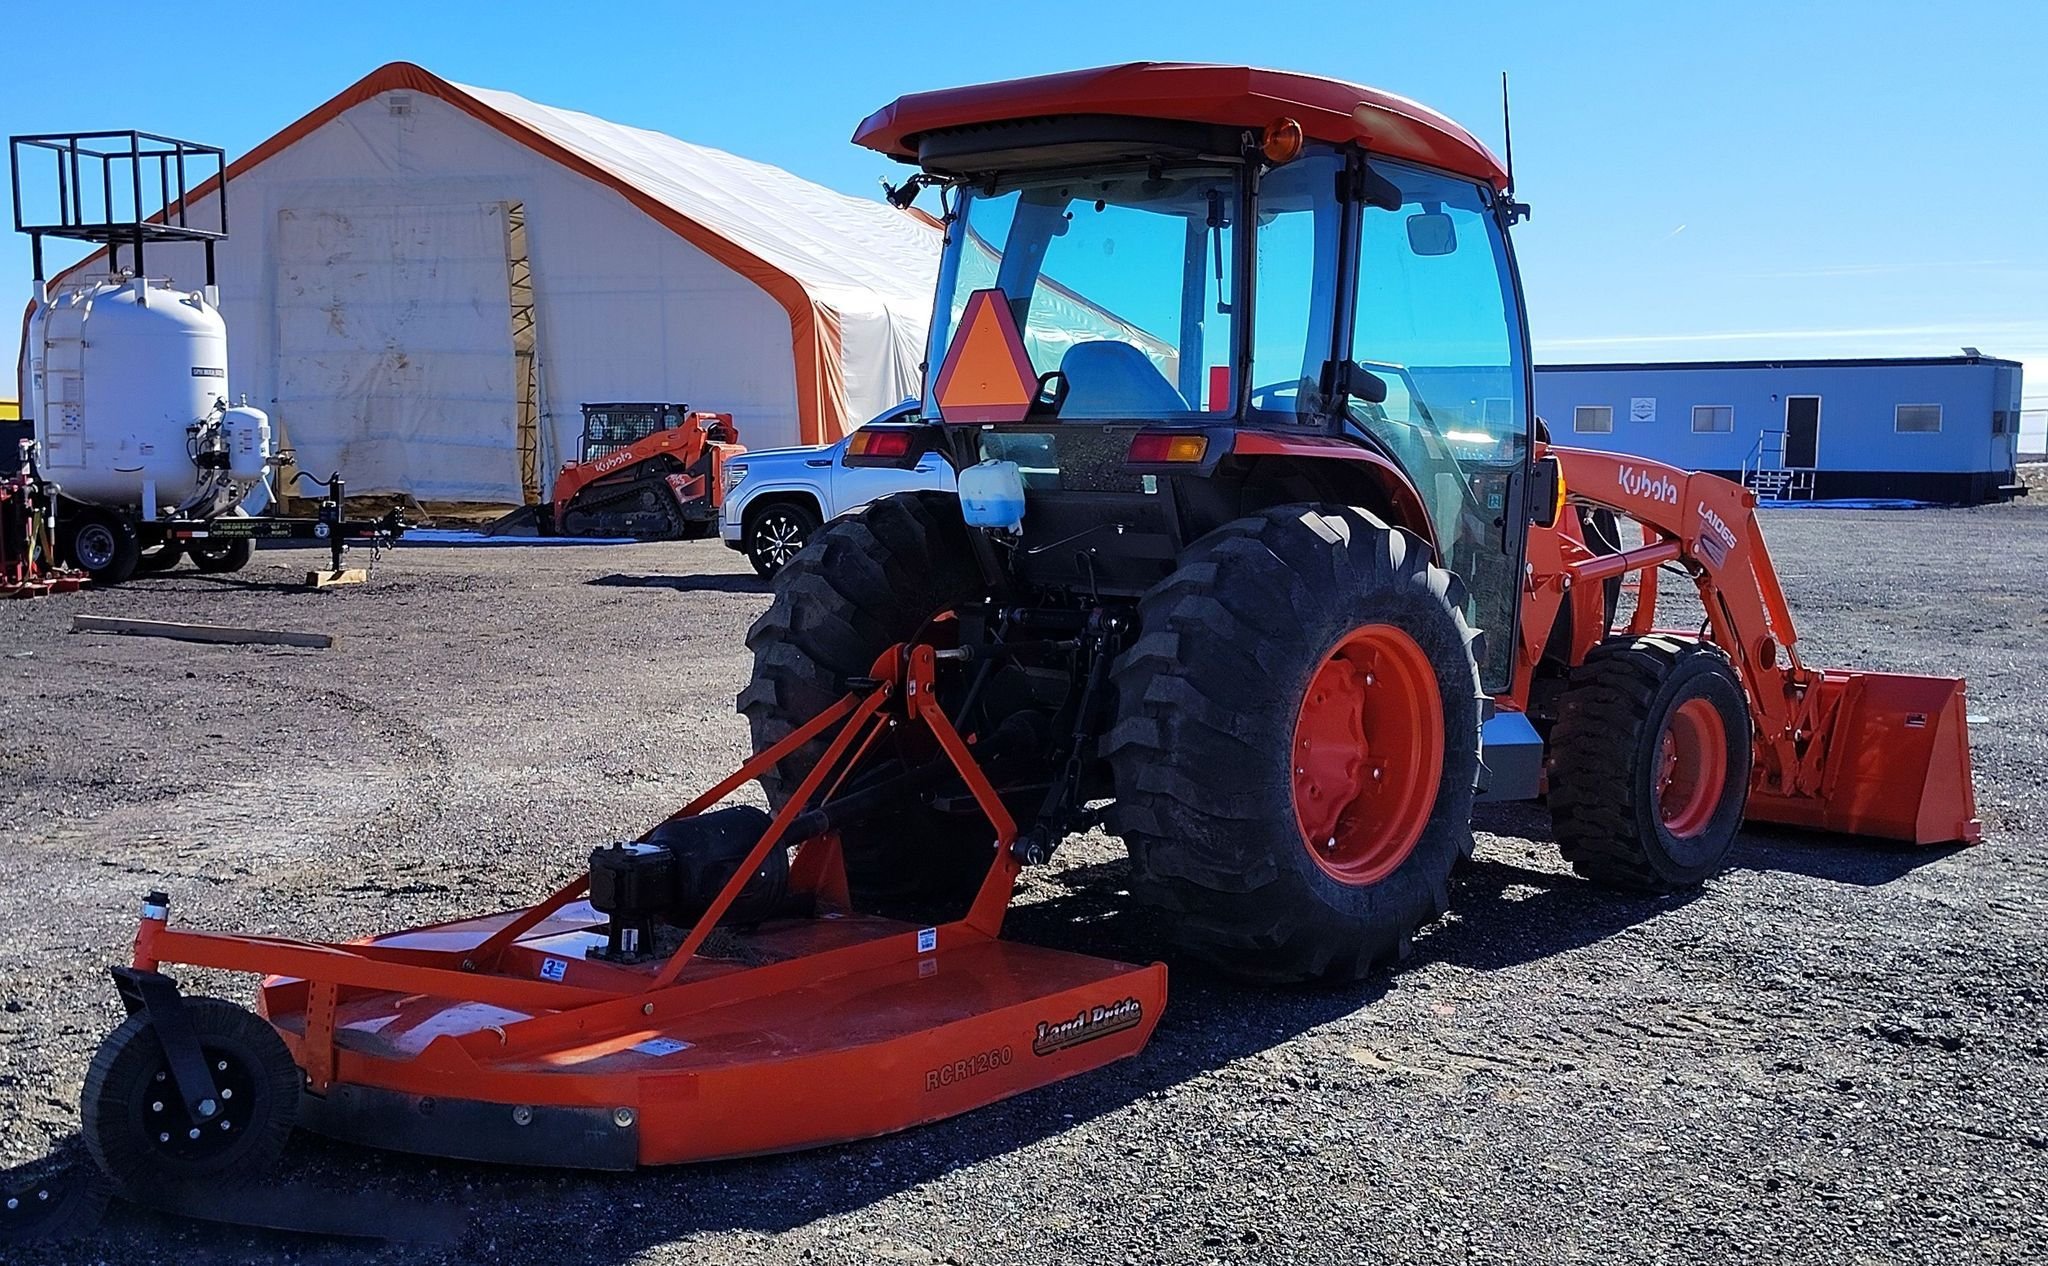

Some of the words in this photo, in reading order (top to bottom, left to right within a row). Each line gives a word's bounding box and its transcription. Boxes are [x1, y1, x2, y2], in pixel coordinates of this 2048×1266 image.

[594, 452, 632, 472] Kubota
[1618, 464, 1677, 505] Kubota
[1697, 500, 1738, 550] LA1065
[543, 960, 555, 974] 3
[1037, 1012, 1085, 1044] Land
[1091, 1000, 1141, 1028] Pride
[925, 1045, 1012, 1092] RCR1260
